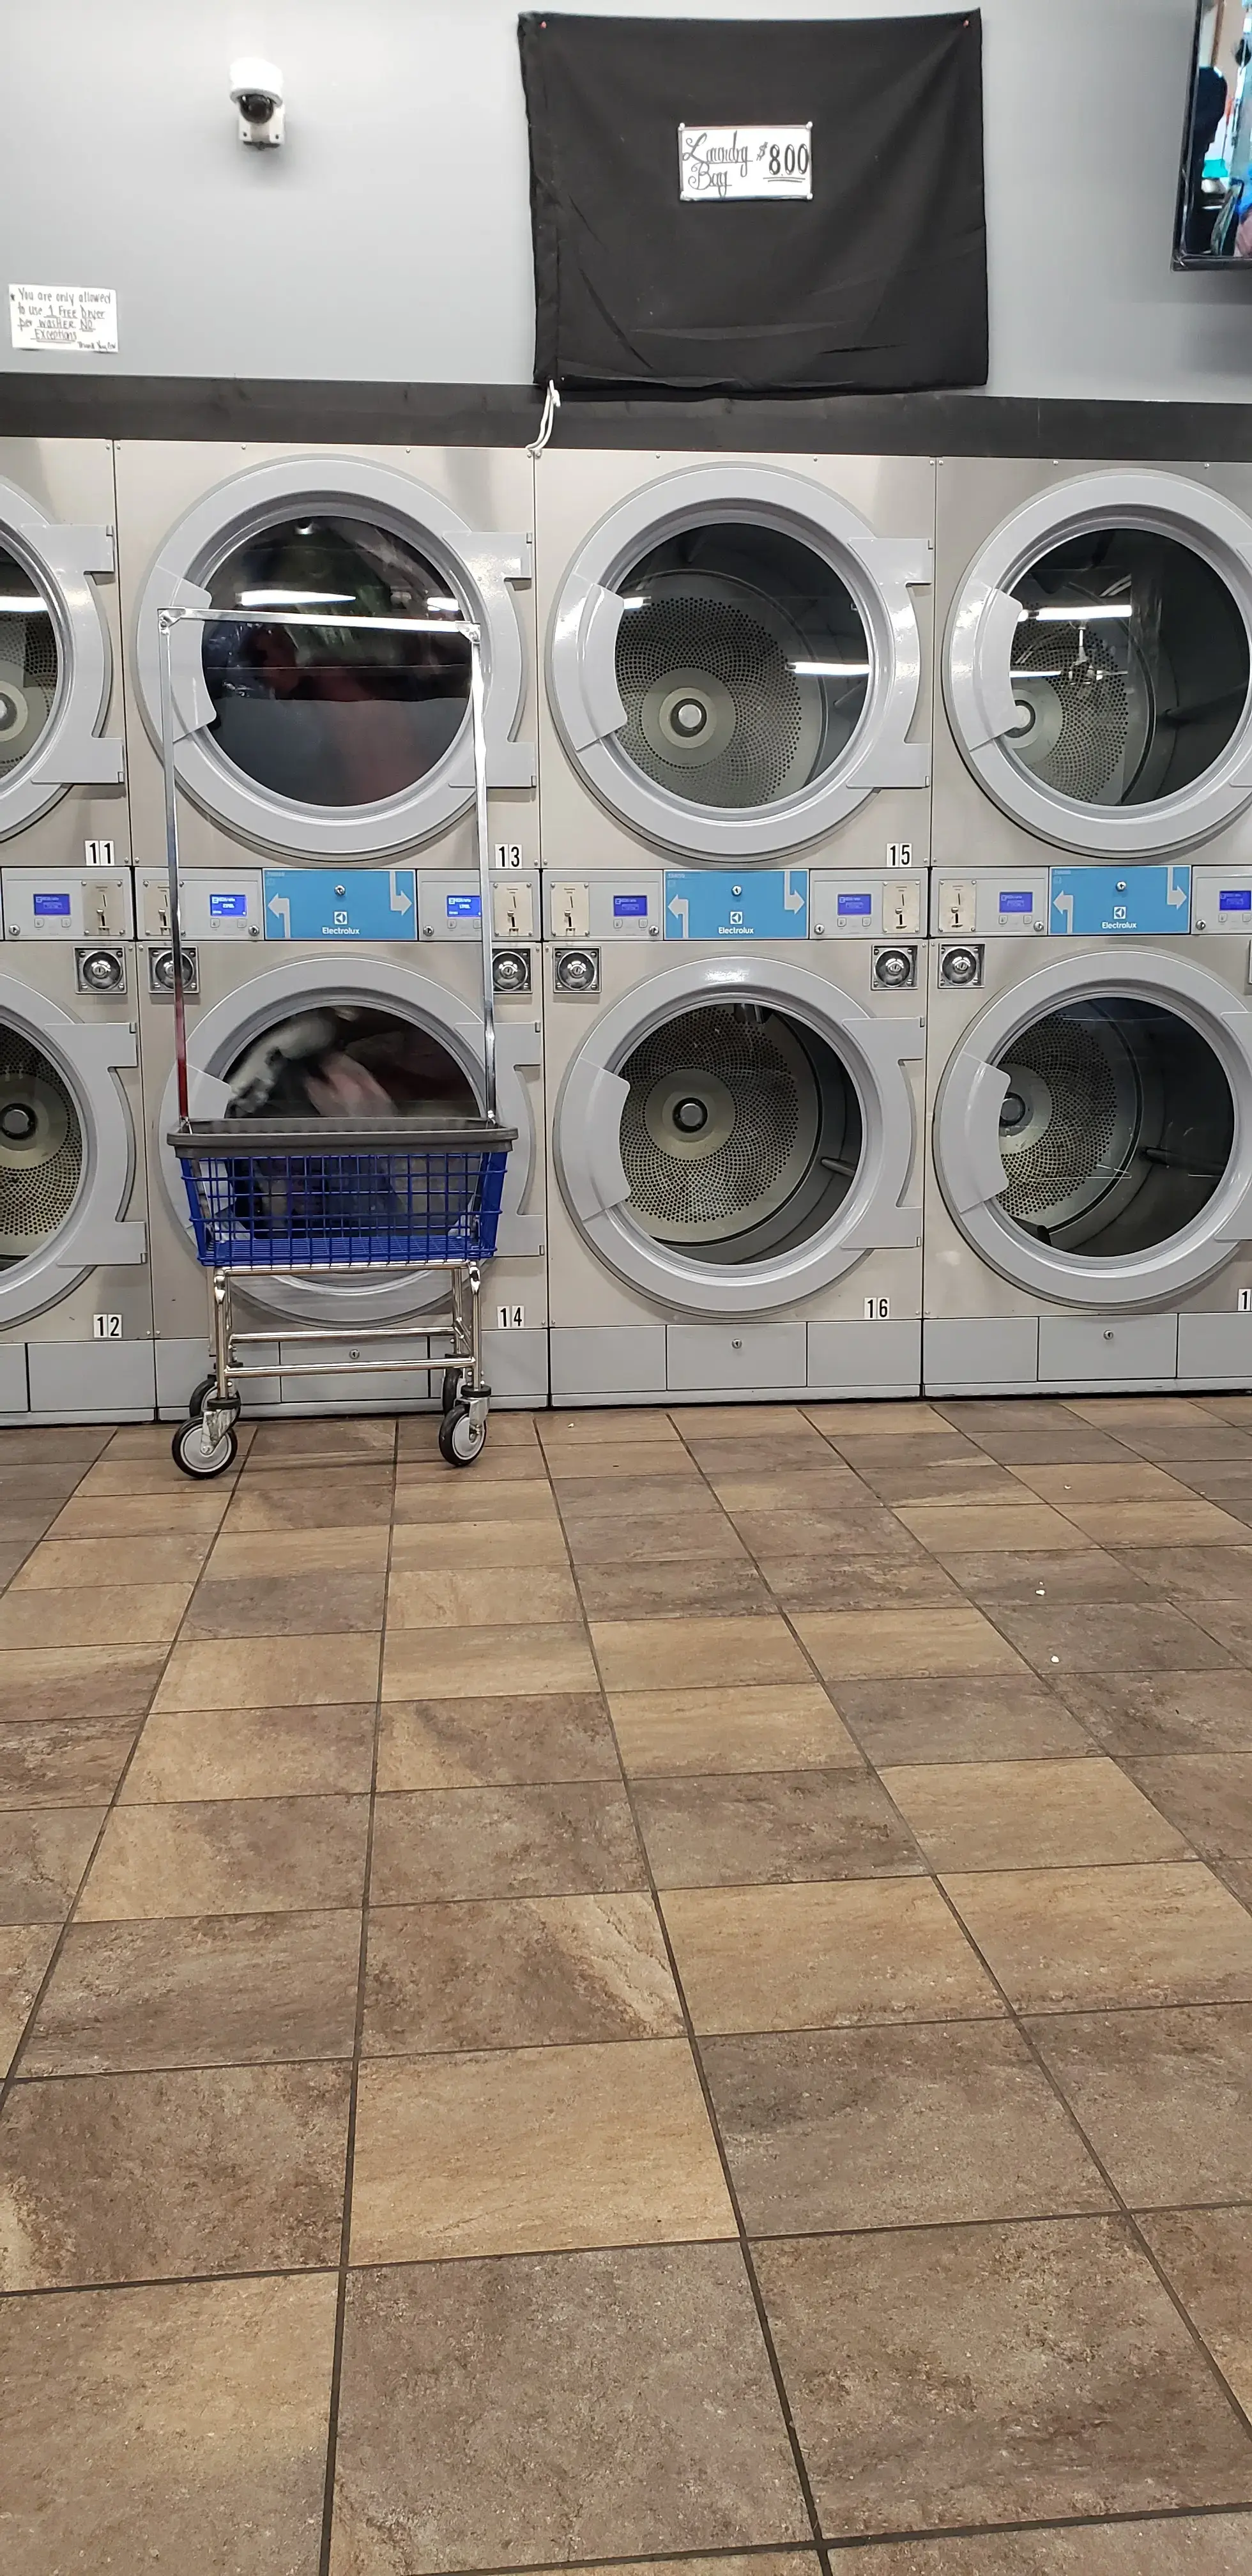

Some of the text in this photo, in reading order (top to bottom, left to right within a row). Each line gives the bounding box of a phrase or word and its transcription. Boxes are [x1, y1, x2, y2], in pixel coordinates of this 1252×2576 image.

[688, 162, 731, 197] Bag
[19, 288, 111, 307] You are only allowed
[18, 302, 26, 314] to
[29, 306, 42, 315] use
[89, 843, 112, 865] 11
[498, 846, 520, 868] 13
[890, 845, 910, 866] 15
[322, 926, 360, 935] Electrolux
[719, 926, 754, 935] Electrolux
[1102, 921, 1136, 930] Electrolux
[500, 1307, 522, 1328] 14
[867, 1298, 888, 1318] 16
[97, 1316, 119, 1337] 12
